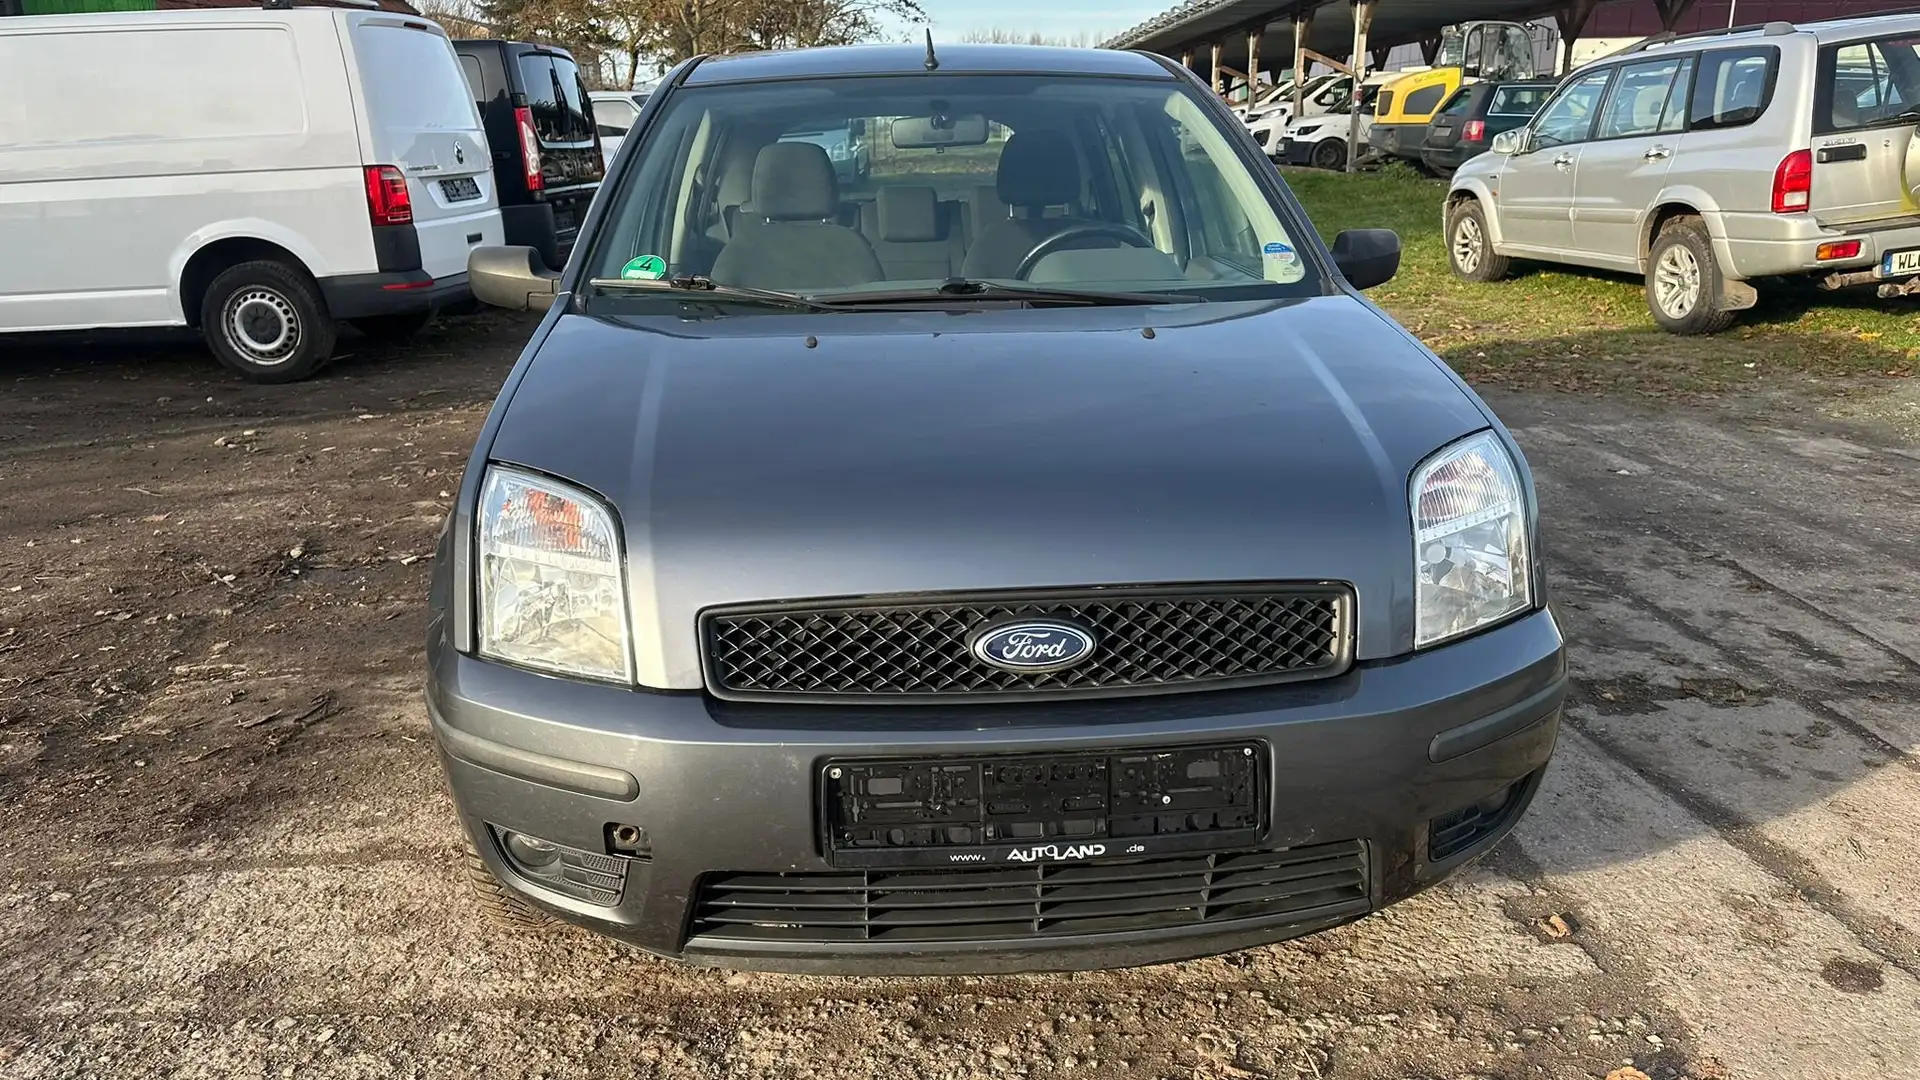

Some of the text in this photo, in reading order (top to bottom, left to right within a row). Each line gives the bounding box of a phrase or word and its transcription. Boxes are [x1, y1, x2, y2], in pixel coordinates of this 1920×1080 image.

[639, 257, 655, 270] 4
[1898, 253, 1920, 270] WL
[1002, 632, 1067, 659] Ford
[950, 844, 1145, 862] www. AUTOLAND .de
